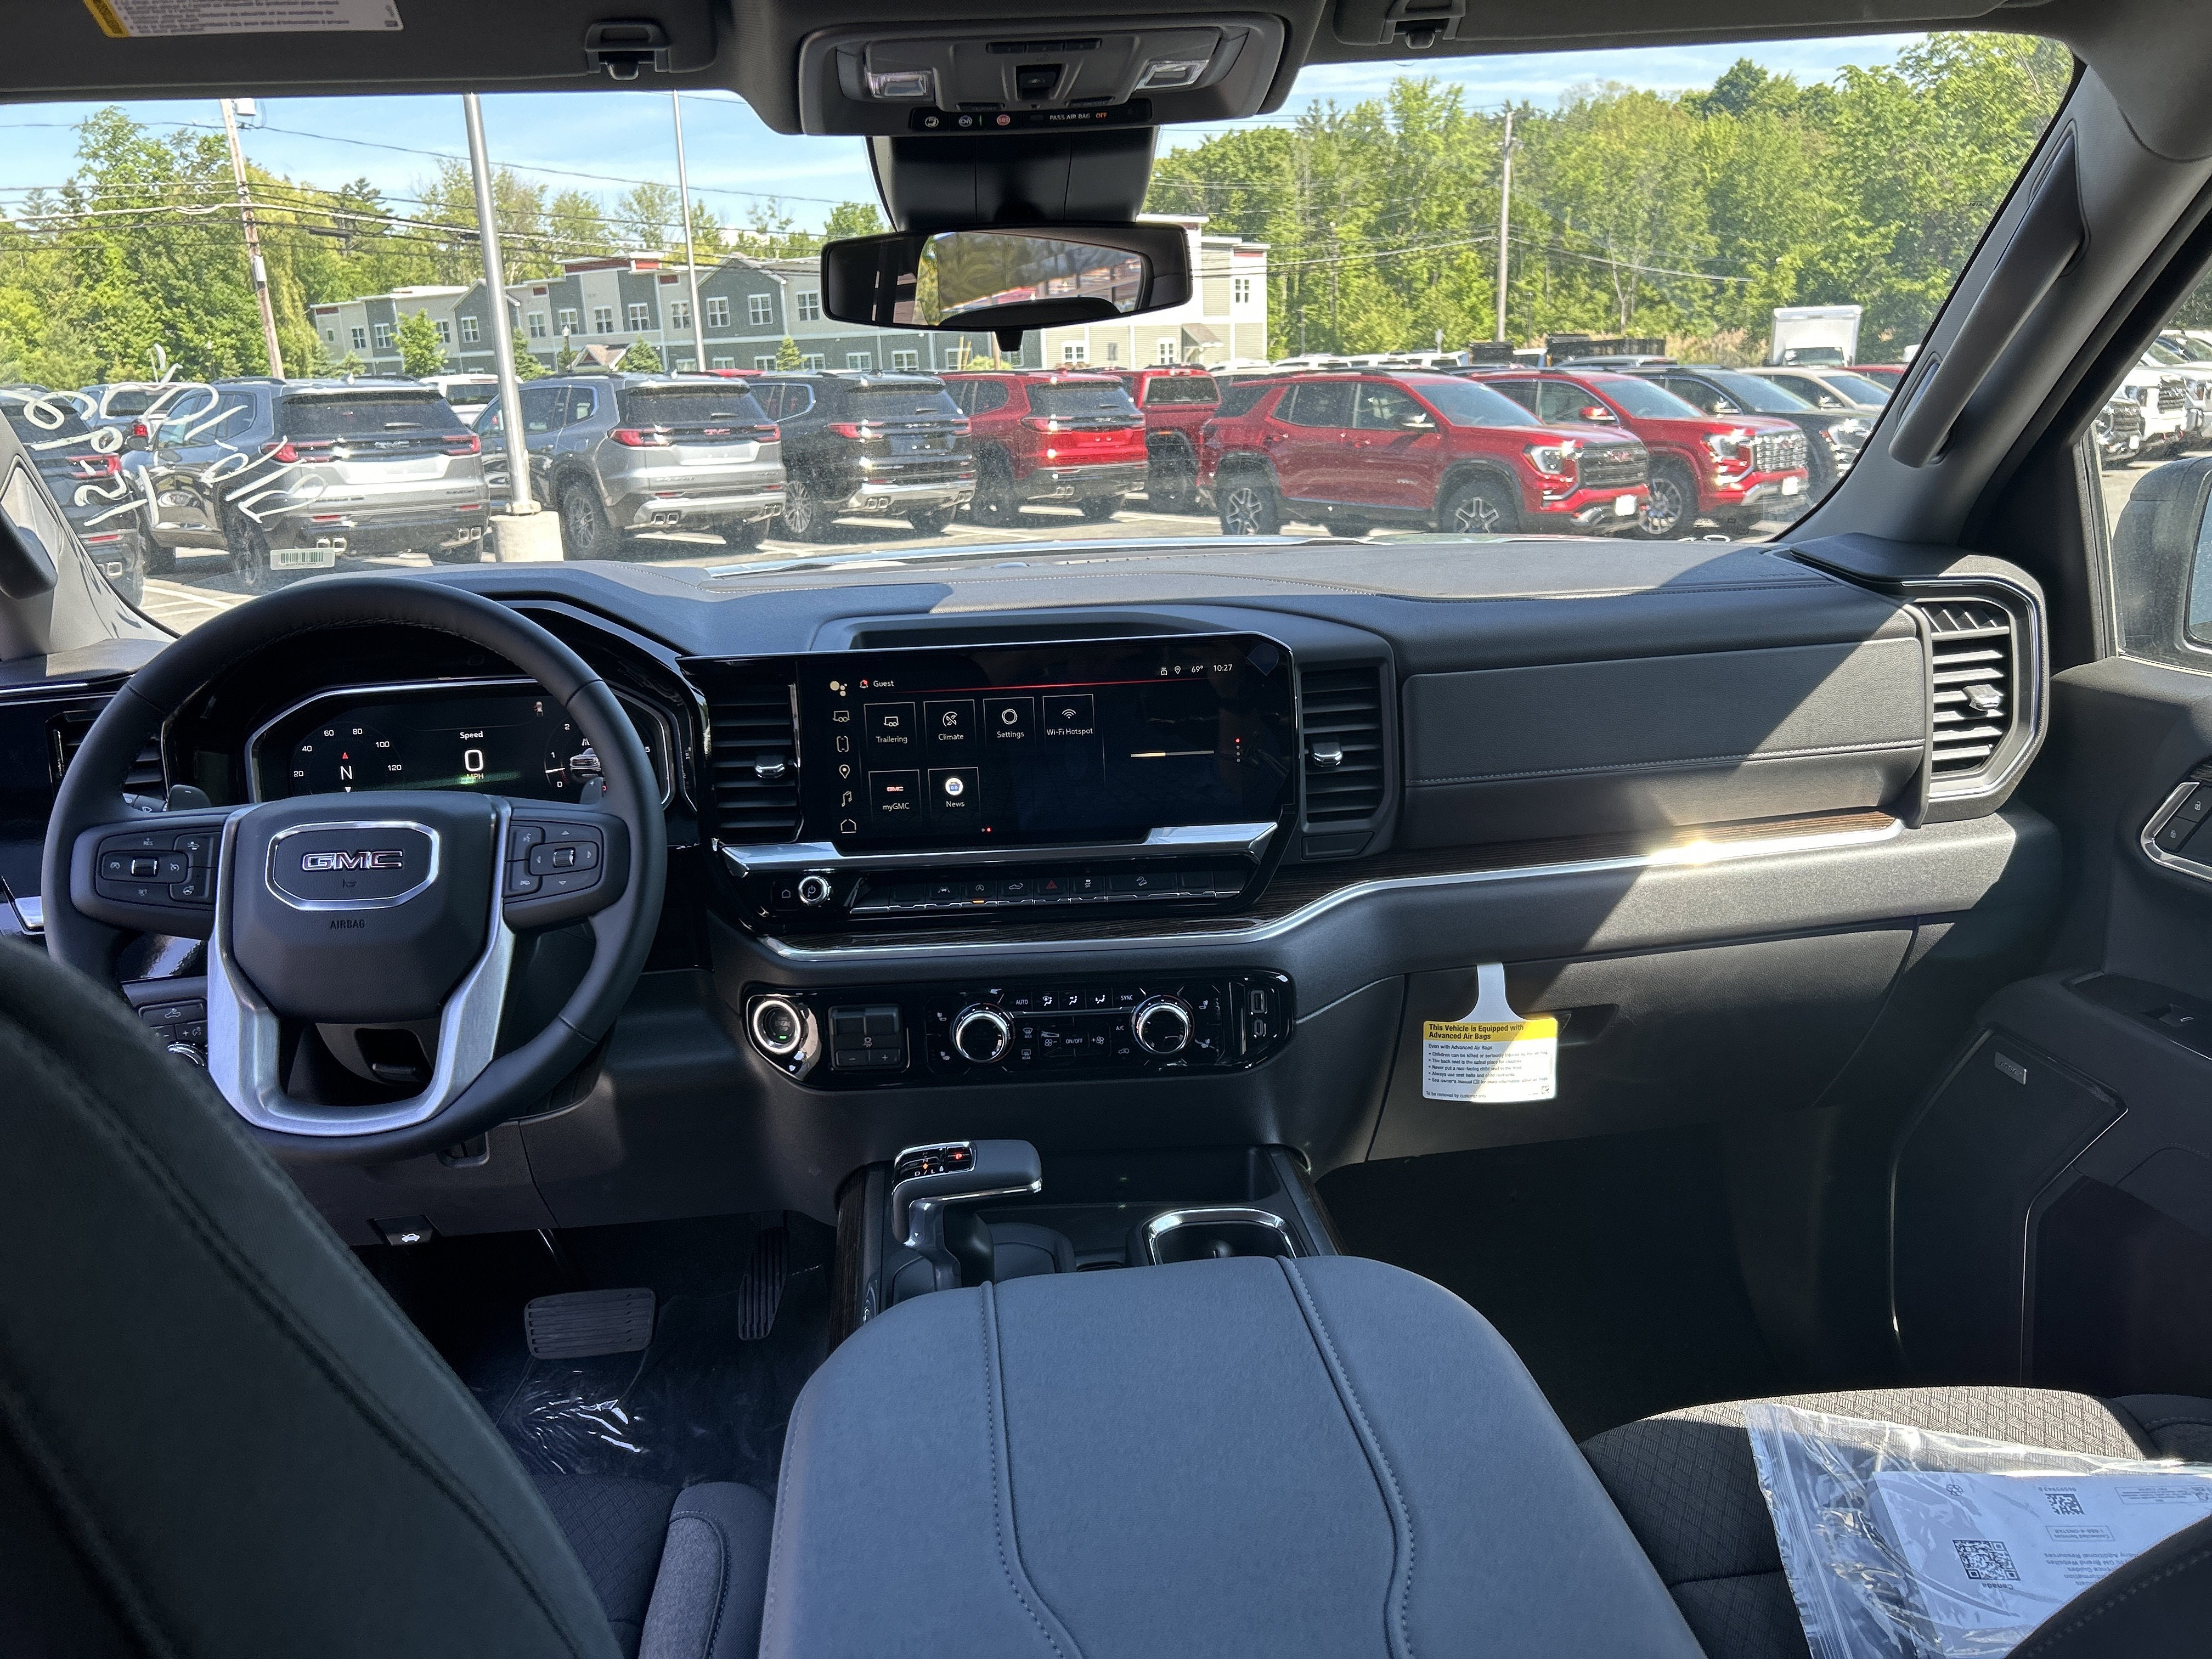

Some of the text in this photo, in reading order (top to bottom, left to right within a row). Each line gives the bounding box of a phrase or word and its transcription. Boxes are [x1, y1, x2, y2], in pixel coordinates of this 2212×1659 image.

[1191, 664, 1233, 673] 69° 10:27
[460, 730, 483, 740] Speed
[997, 731, 1025, 739] Settings
[1065, 728, 1093, 736] Hotspot
[876, 736, 908, 744] Trailering
[465, 749, 483, 771] 0
[340, 765, 353, 780] N
[882, 802, 910, 812] myGMC
[302, 851, 403, 871] GMC
[330, 919, 365, 929] AIRBAG
